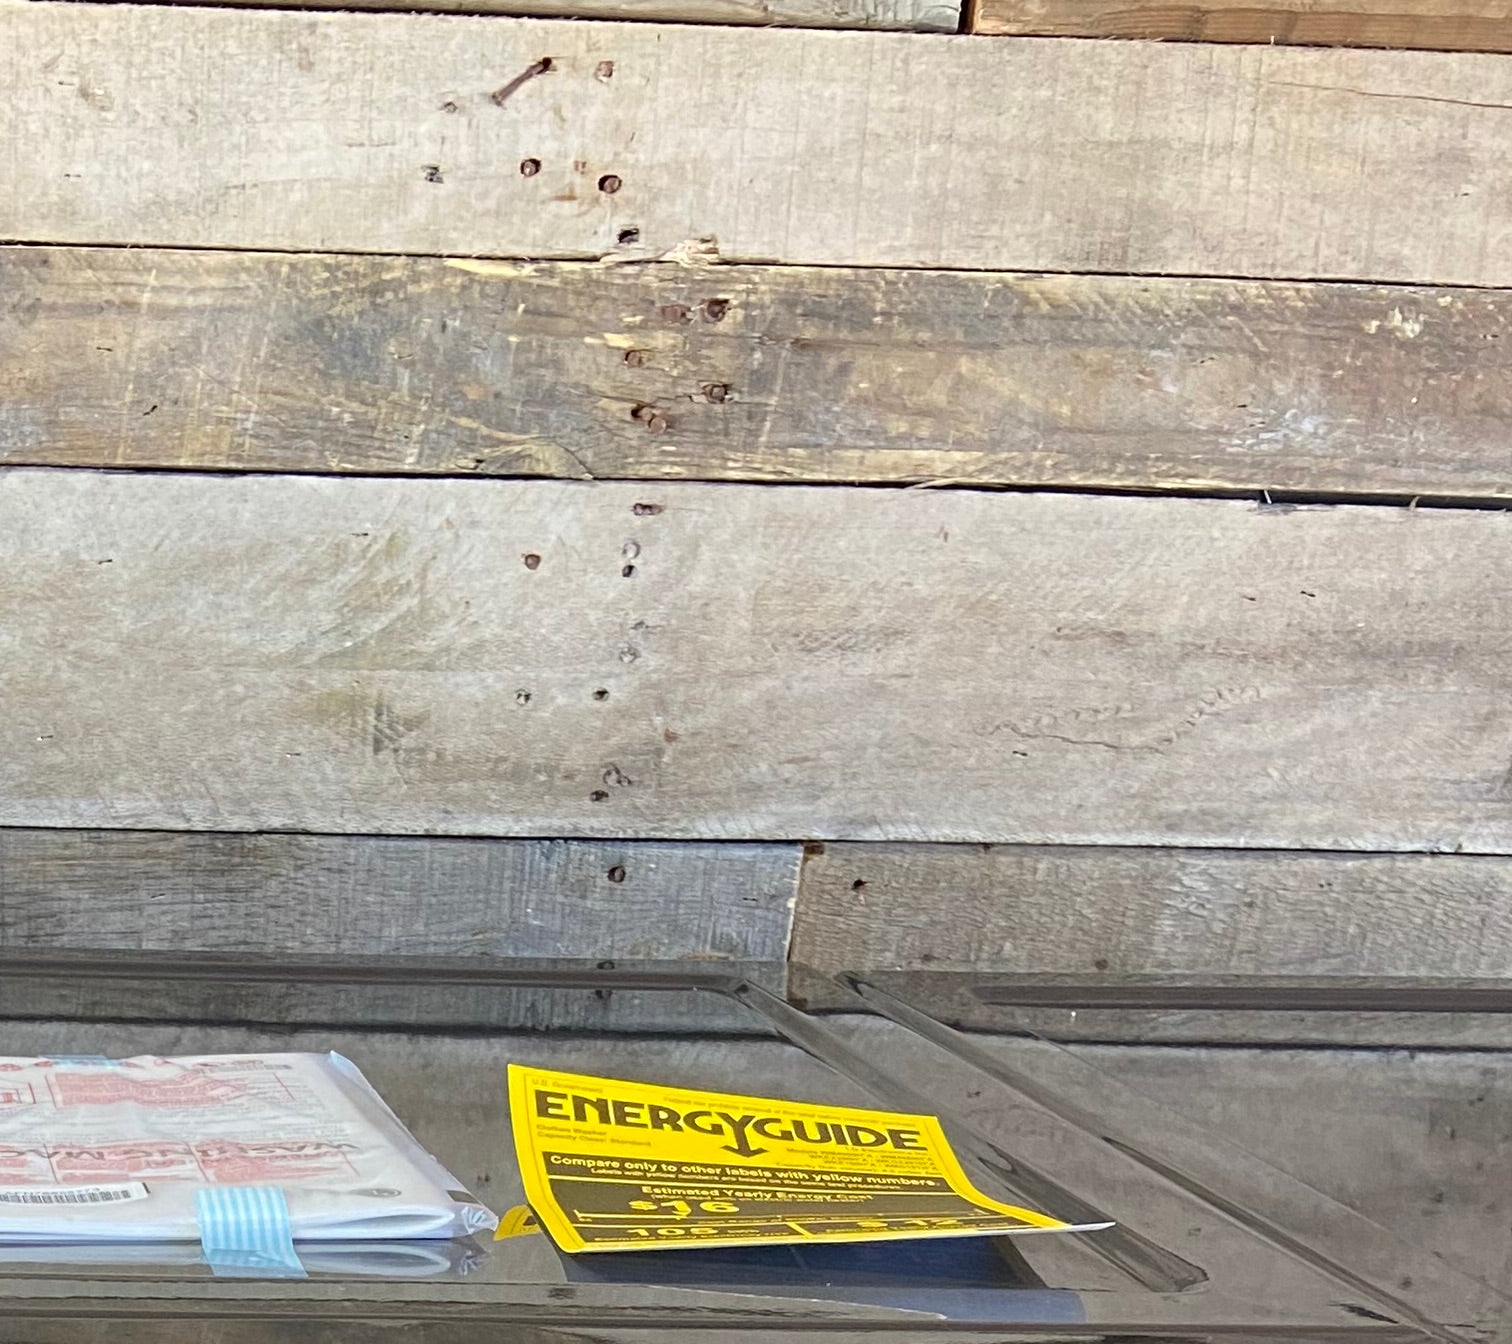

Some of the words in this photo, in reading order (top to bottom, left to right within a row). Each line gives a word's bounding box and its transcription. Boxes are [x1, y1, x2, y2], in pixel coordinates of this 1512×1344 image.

[535, 1089, 927, 1155] ENERGYGUIDE
[550, 1155, 620, 1168] Compare
[624, 1161, 657, 1172] only
[661, 1163, 677, 1172] to
[681, 1165, 721, 1175] other
[725, 1167, 772, 1178] labels
[776, 1170, 809, 1180] with
[813, 1172, 863, 1184] yellow
[641, 1186, 720, 1198] Estimated
